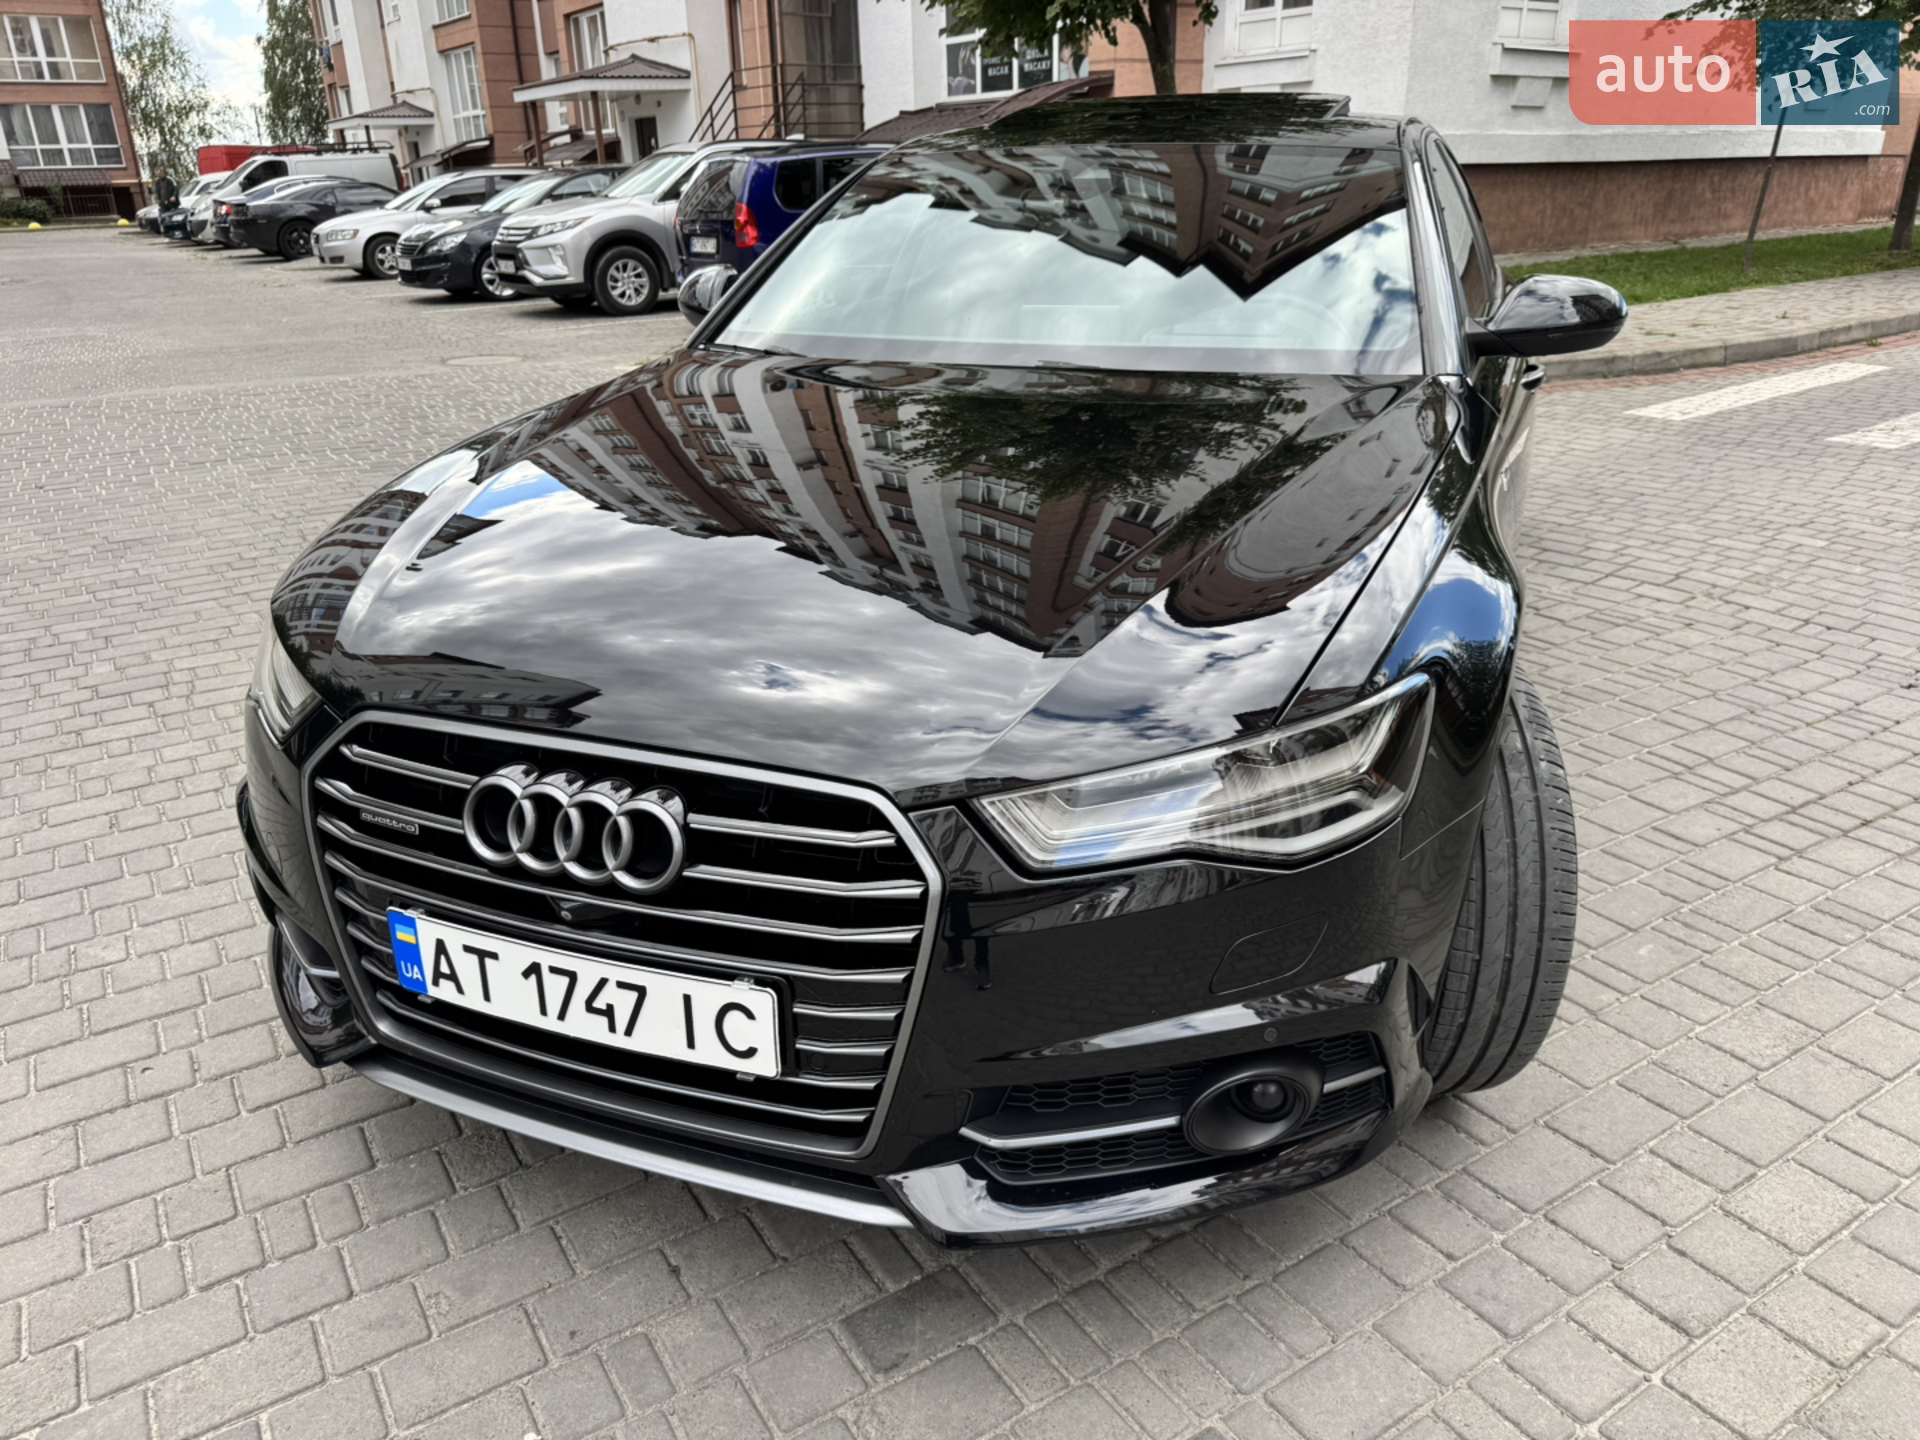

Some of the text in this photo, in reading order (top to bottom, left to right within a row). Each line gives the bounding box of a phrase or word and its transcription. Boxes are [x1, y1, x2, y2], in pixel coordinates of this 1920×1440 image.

[361, 812, 416, 832] quattro
[400, 960, 423, 982] UA
[431, 937, 759, 1060] AT 1747 IC
